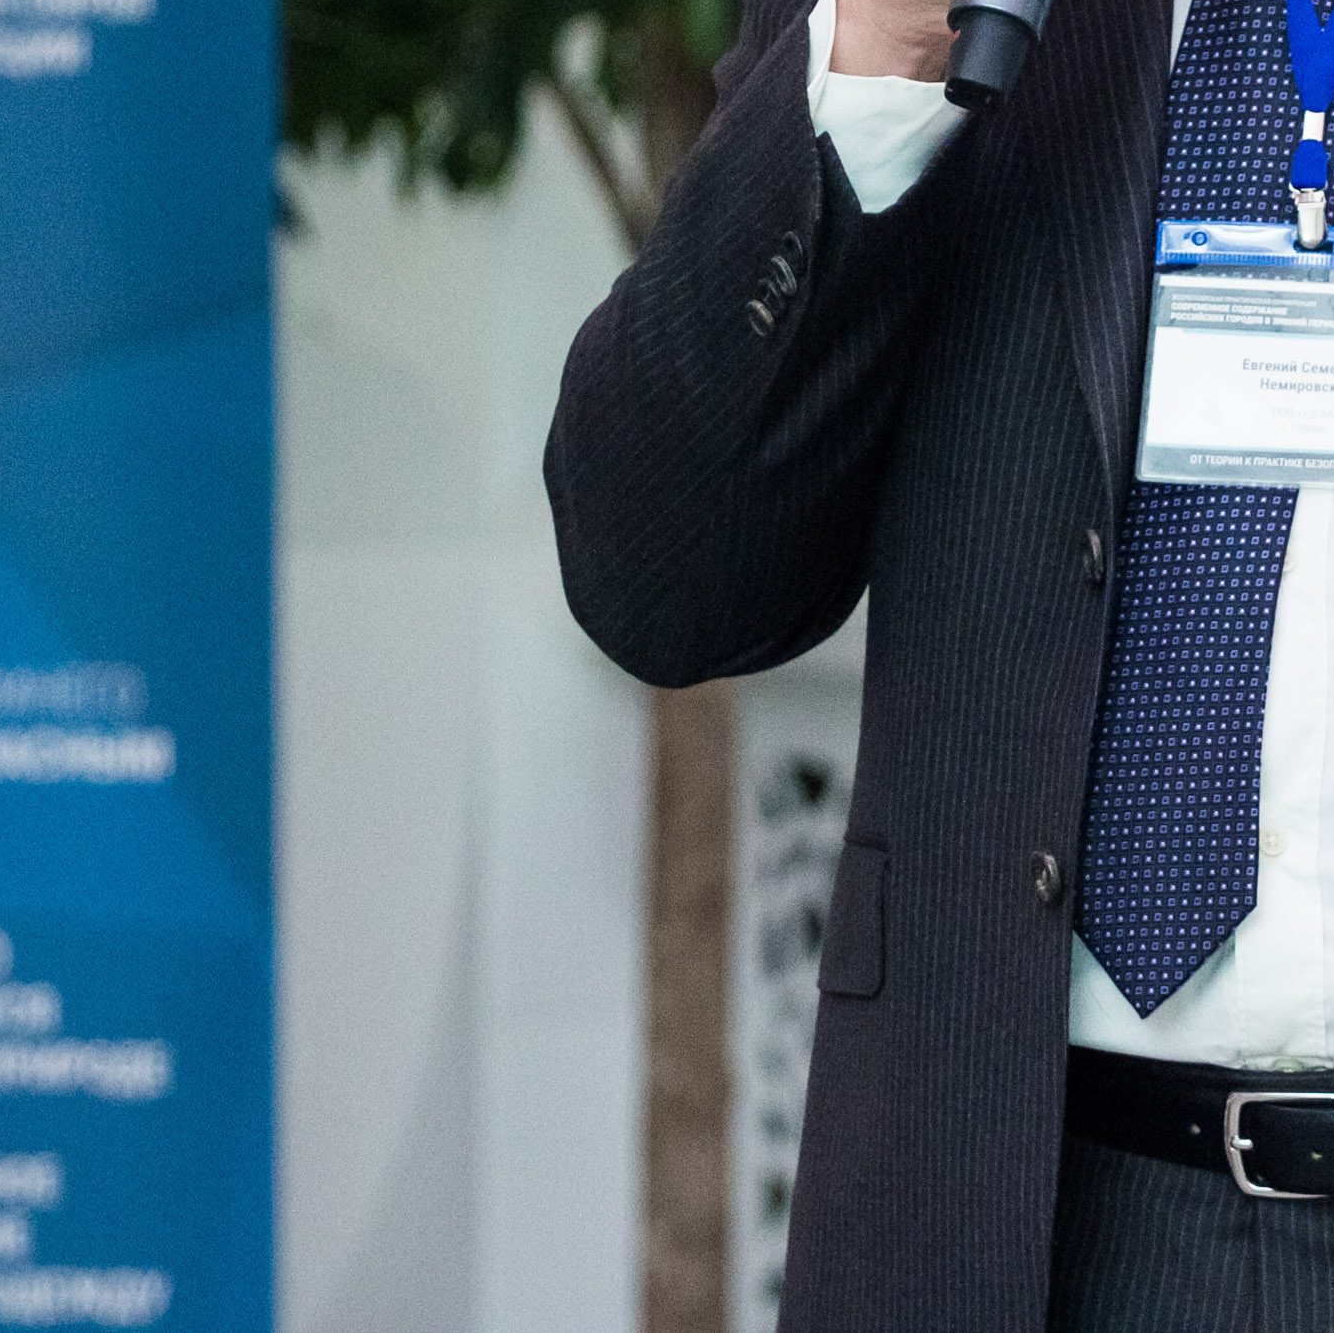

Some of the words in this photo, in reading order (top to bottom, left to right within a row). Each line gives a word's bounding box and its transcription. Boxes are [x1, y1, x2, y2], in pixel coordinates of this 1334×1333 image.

[1170, 301, 1230, 313] СОВРЕМЕННОЕ
[1231, 304, 1287, 316] СОДЕРЖАНИЕ
[1242, 358, 1297, 373] Евгений
[1189, 454, 1203, 465] ОТ
[1205, 454, 1243, 466] ТЕОРИИ
[1244, 456, 1253, 467] К
[1253, 456, 1304, 469] ПРАКТИКЕ
